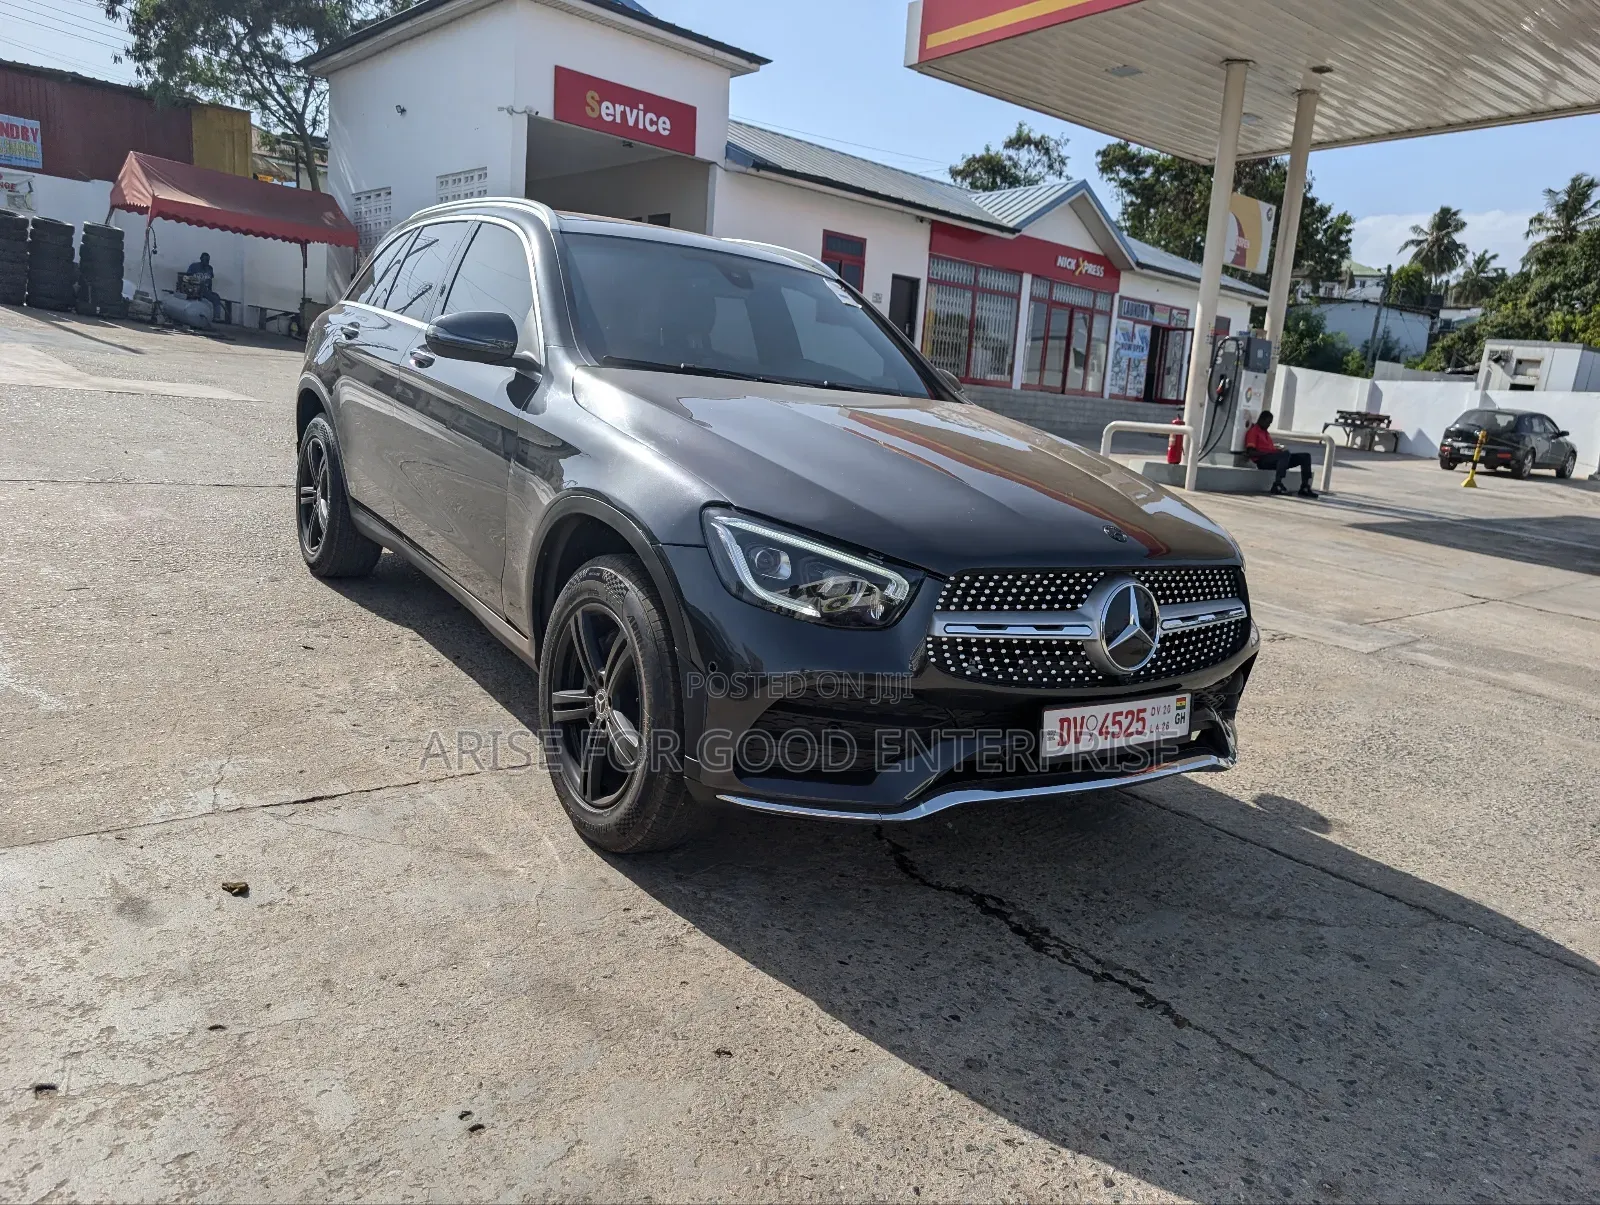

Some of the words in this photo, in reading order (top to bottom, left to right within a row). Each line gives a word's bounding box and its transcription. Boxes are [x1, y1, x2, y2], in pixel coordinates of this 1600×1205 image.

[585, 90, 671, 136] Service
[1056, 255, 1076, 271] NICK
[1075, 257, 1104, 277] XPRESS
[1123, 300, 1149, 319] LAUNDRY
[1057, 715, 1086, 746] DV
[1098, 707, 1147, 740] 4525
[1175, 712, 1186, 725] GH
